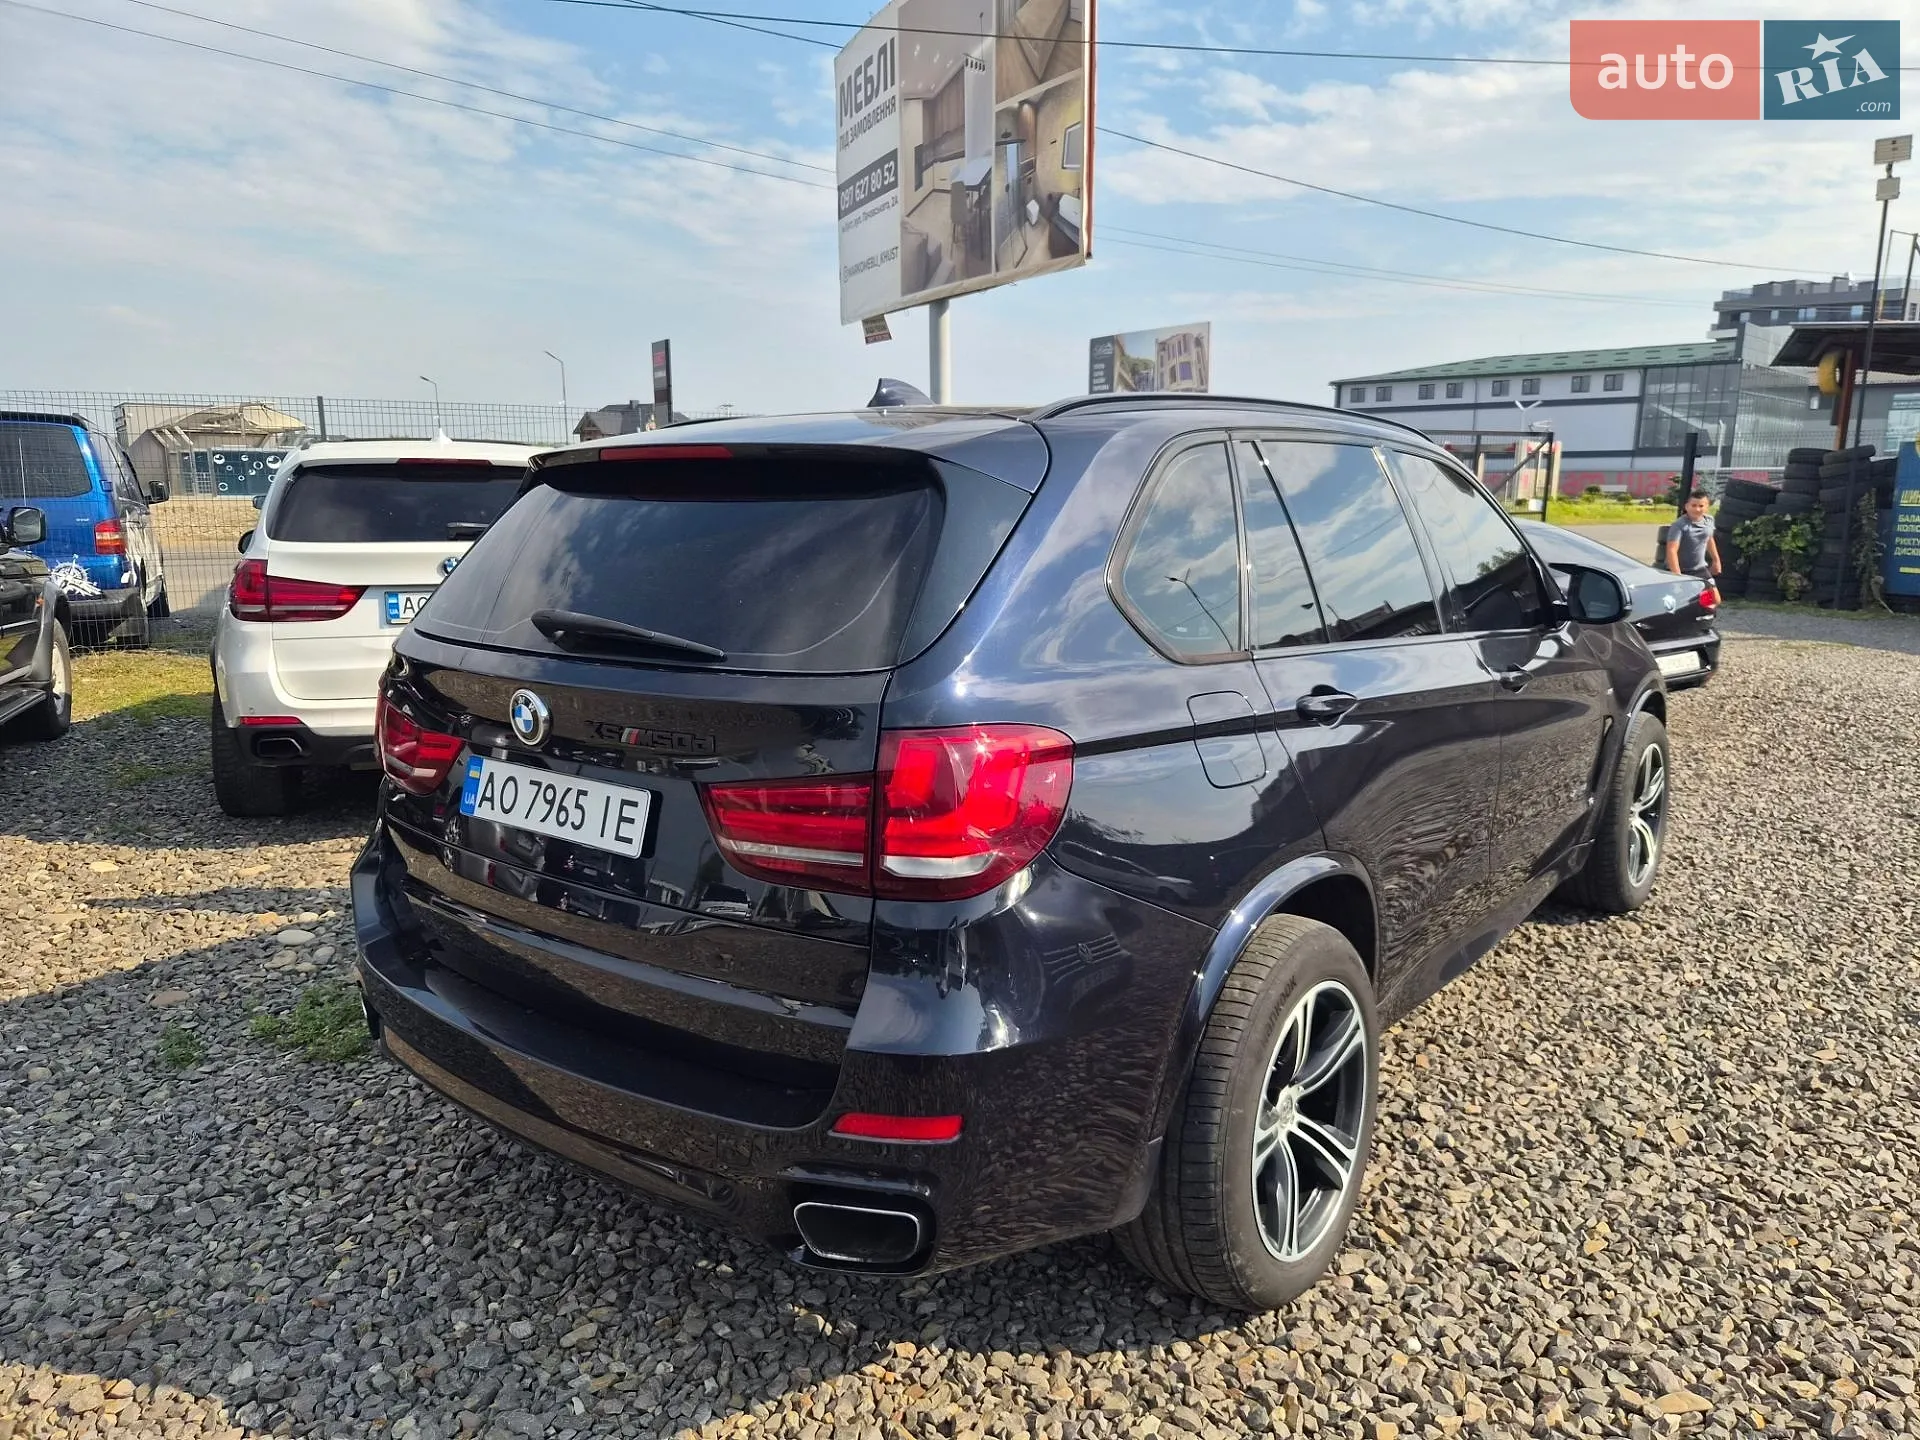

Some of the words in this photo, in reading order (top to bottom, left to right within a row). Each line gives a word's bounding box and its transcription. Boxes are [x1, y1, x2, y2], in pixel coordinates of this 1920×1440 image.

[840, 37, 895, 127] МЕБЛІ
[850, 95, 896, 143] ЗАМОВЛЕННЯ
[840, 185, 854, 211] 097
[855, 175, 869, 201] 627
[870, 168, 882, 192] 80
[883, 160, 895, 185] 52
[464, 792, 476, 806] UA
[478, 771, 519, 815] AO
[525, 779, 589, 831] 7965
[600, 795, 639, 845] IE
